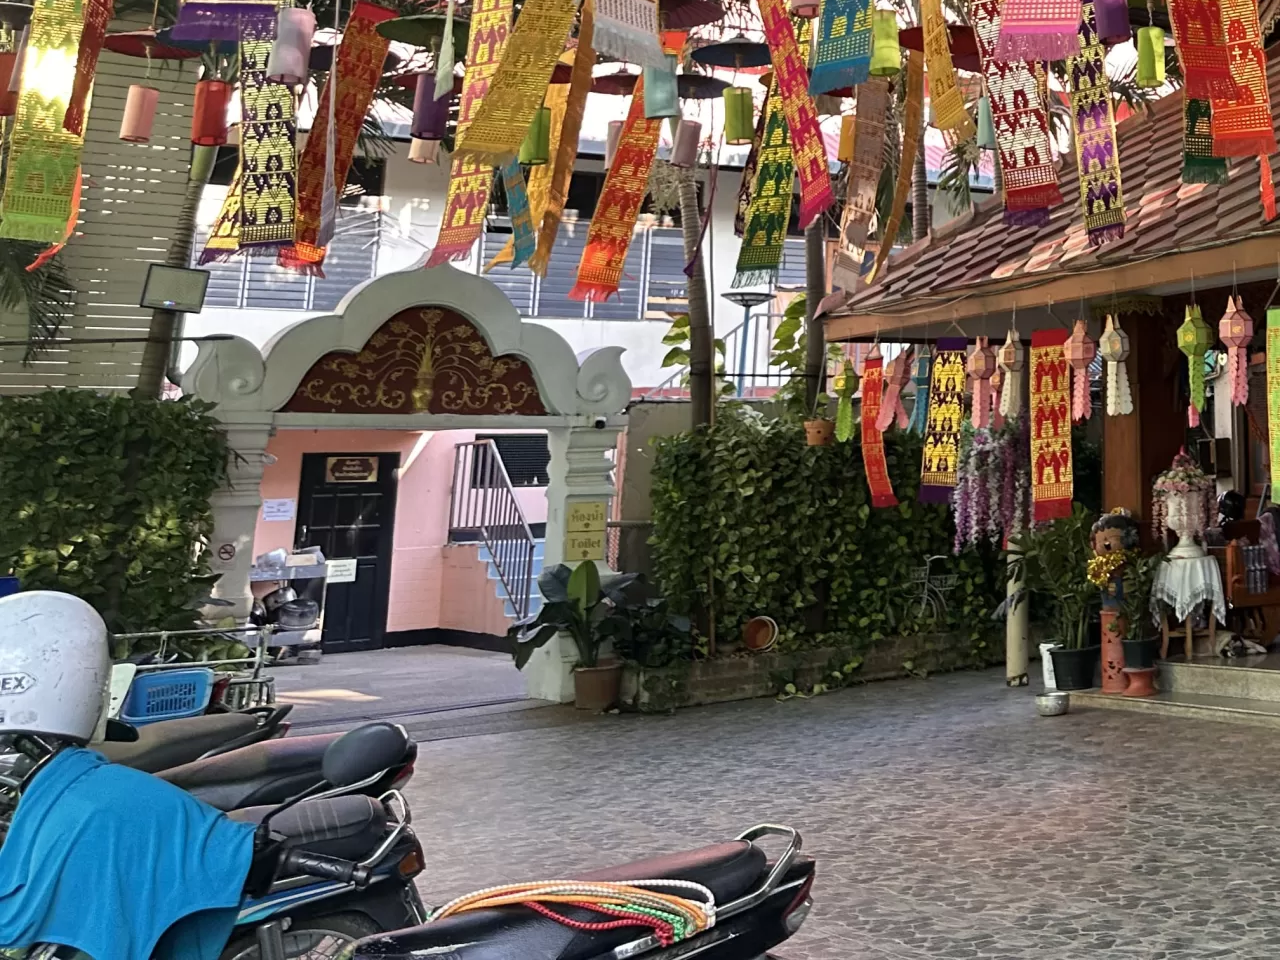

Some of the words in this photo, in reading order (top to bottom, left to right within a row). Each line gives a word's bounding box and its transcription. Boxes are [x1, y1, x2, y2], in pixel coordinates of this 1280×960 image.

[571, 504, 604, 522] ห้องน้ำ
[570, 538, 601, 549] Toilet
[0, 676, 26, 691] EX
